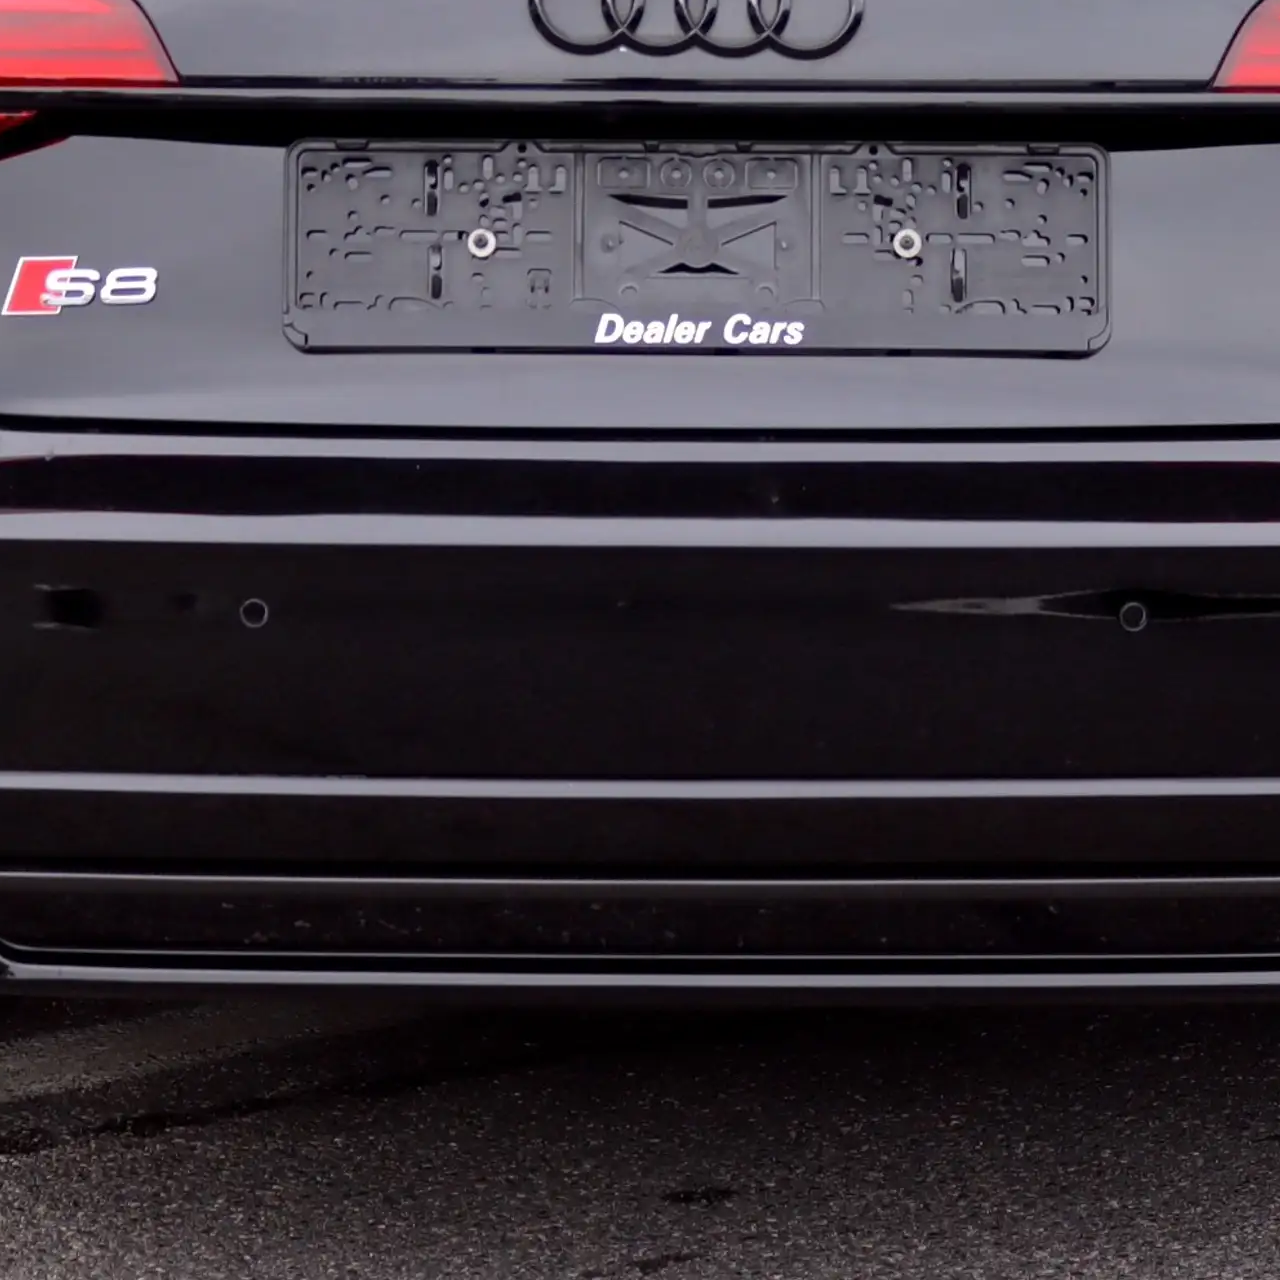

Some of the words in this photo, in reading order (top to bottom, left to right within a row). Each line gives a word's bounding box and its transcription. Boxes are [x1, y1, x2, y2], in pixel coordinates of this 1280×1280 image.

[40, 266, 159, 307] S8
[594, 313, 712, 344] Dealer
[723, 313, 806, 345] Cars
